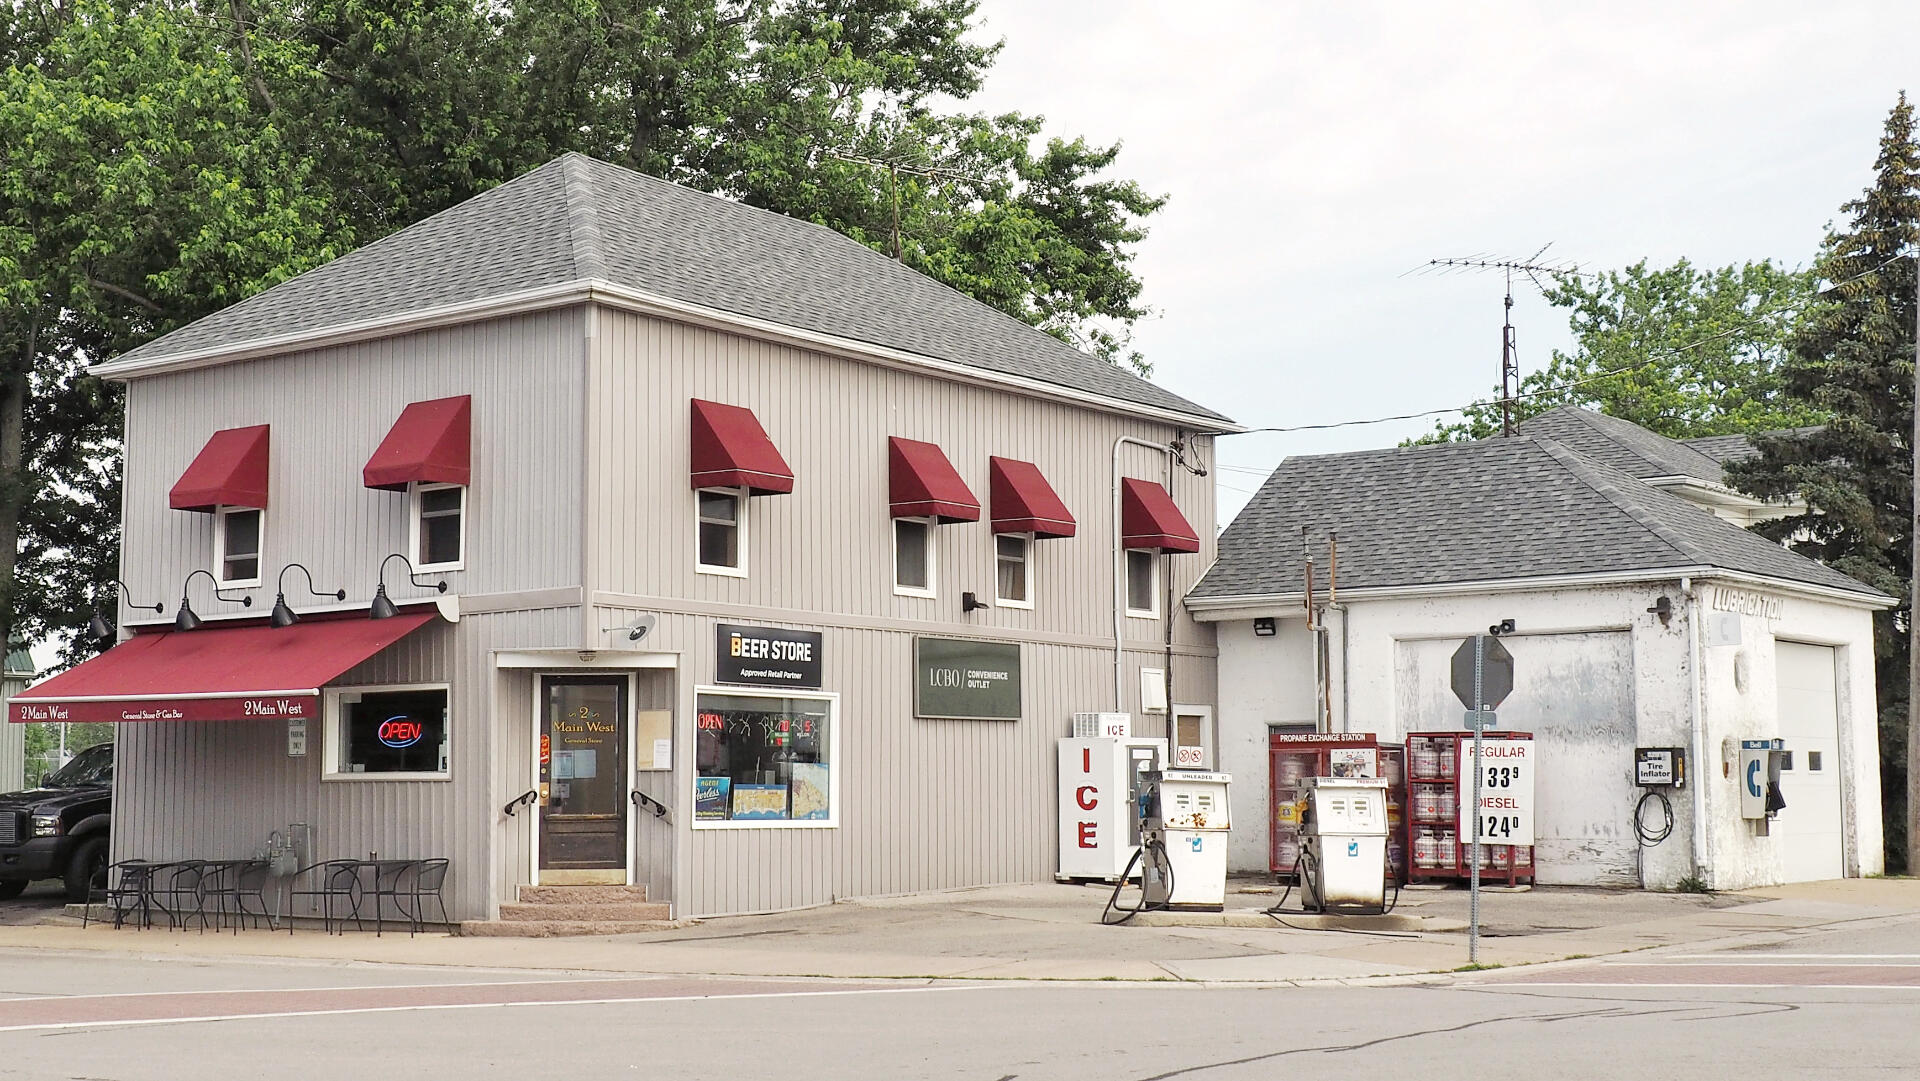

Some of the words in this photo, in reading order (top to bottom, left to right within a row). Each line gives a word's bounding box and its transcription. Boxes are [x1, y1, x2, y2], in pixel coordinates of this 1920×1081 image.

[731, 633, 769, 659] BEER
[771, 640, 812, 662] STORE
[740, 668, 768, 678] Approved
[768, 670, 783, 679] Retail
[783, 671, 803, 680] Partner
[930, 667, 960, 688] LCBO
[967, 670, 1009, 681] CONVENIENCE
[967, 680, 991, 689] OUTLET
[28, 706, 48, 719] Main
[48, 705, 69, 719] West
[252, 700, 276, 715] Main
[276, 699, 303, 714] West
[579, 707, 590, 719] 2
[553, 721, 584, 732] Main
[586, 722, 615, 732] West
[698, 714, 724, 730] OPEN
[380, 722, 422, 739] OPEN
[1107, 725, 1124, 736] ICE
[1308, 734, 1341, 742] EXCHANGE
[1341, 734, 1366, 742] STATION
[1076, 748, 1098, 848] ICE
